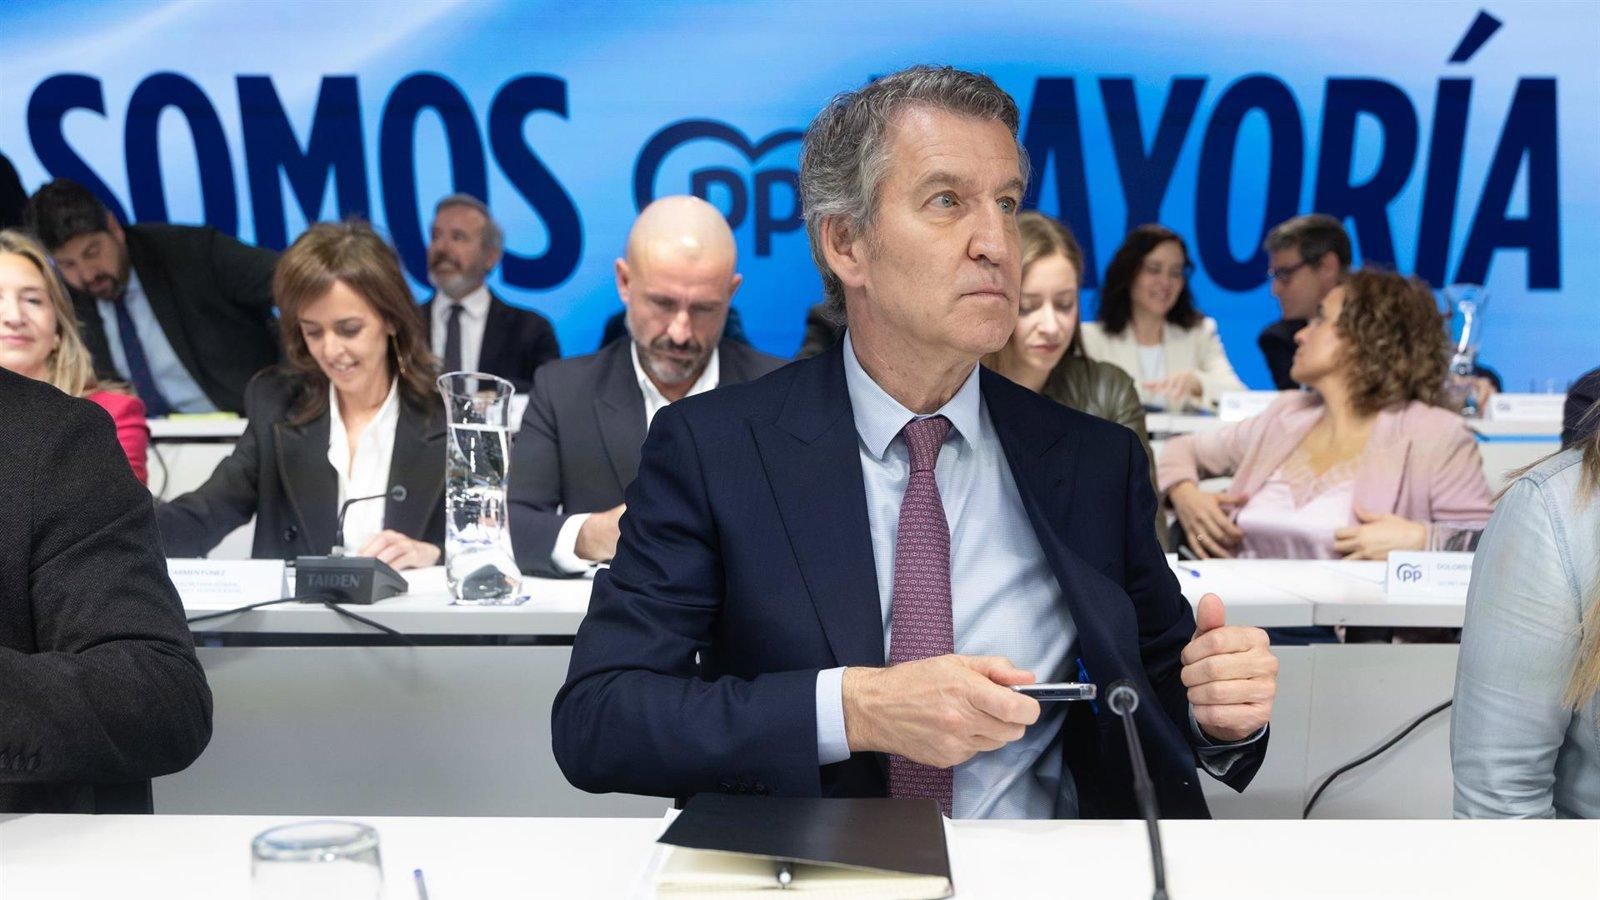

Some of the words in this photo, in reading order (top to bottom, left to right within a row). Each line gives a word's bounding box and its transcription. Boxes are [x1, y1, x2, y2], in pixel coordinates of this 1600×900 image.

[27, 71, 582, 290] SOMOS
[869, 9, 1563, 291] AYORÍA
[306, 573, 360, 588] TAIDEN
